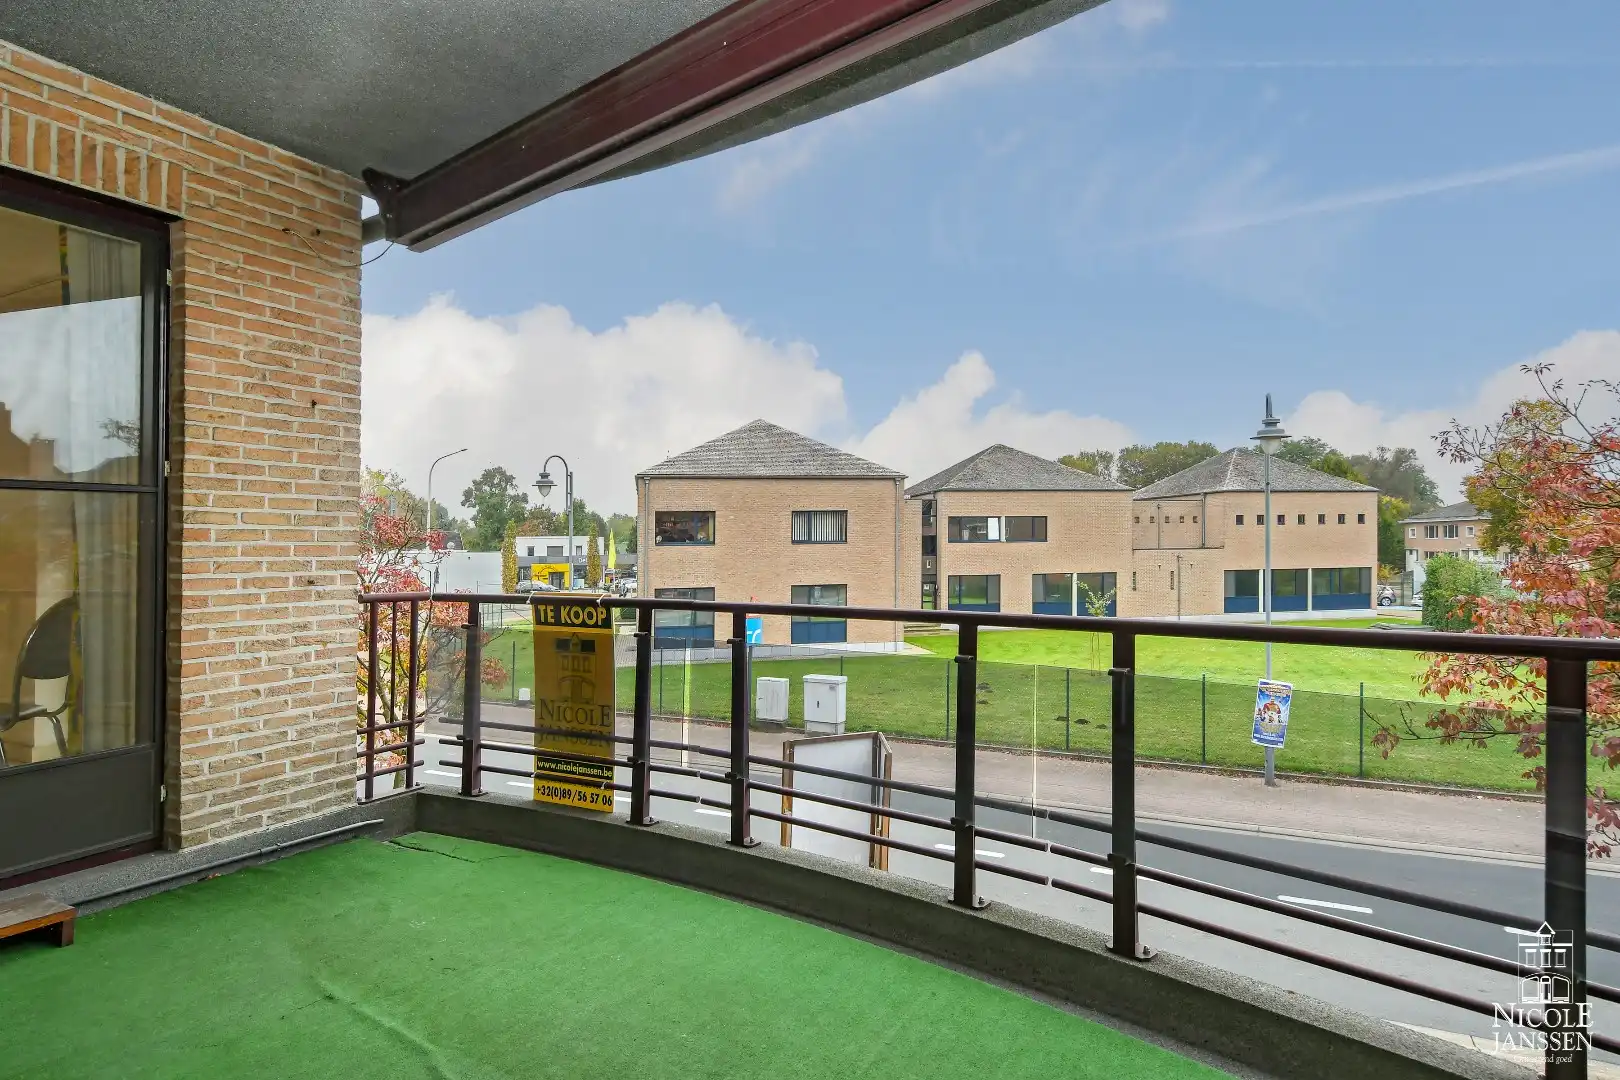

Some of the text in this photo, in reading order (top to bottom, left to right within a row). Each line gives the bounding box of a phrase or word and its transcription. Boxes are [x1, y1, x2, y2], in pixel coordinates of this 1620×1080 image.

[538, 605, 607, 625] TE KOOP
[537, 699, 612, 727] NICOLE
[537, 760, 613, 777] www.nicolejanssen.be
[590, 792, 600, 804] 57
[602, 795, 613, 806] 06
